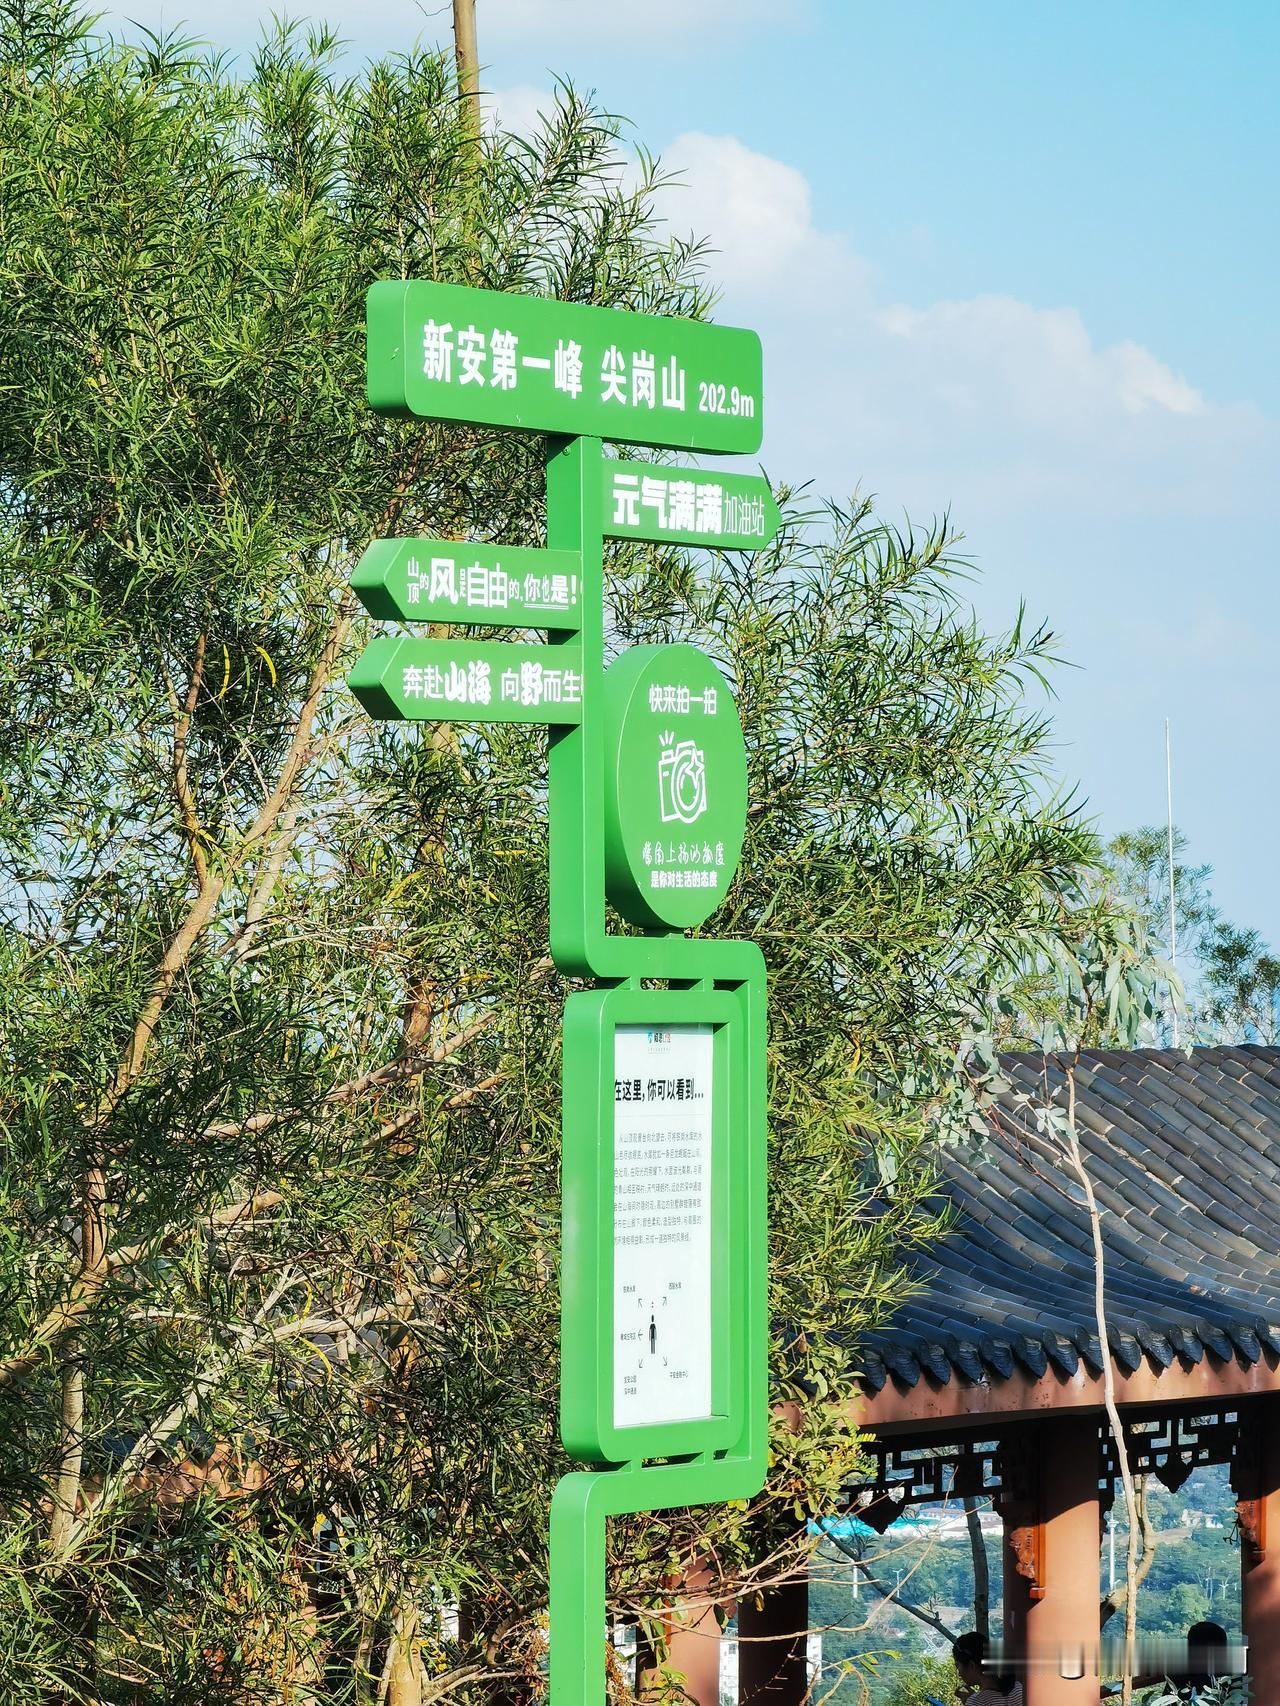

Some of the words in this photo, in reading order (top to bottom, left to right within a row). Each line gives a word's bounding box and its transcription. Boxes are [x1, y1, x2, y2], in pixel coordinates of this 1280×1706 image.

[423, 319, 583, 399] 新安第一峰
[600, 345, 686, 411] 尖岗山
[699, 381, 754, 418] 202.9m
[612, 473, 765, 537] 元气满满加油站
[402, 660, 491, 705] 奔赴山海
[501, 661, 581, 705] 向野而生
[649, 683, 717, 715] 快来拍一拍
[651, 870, 718, 888] 是你对生活的态度
